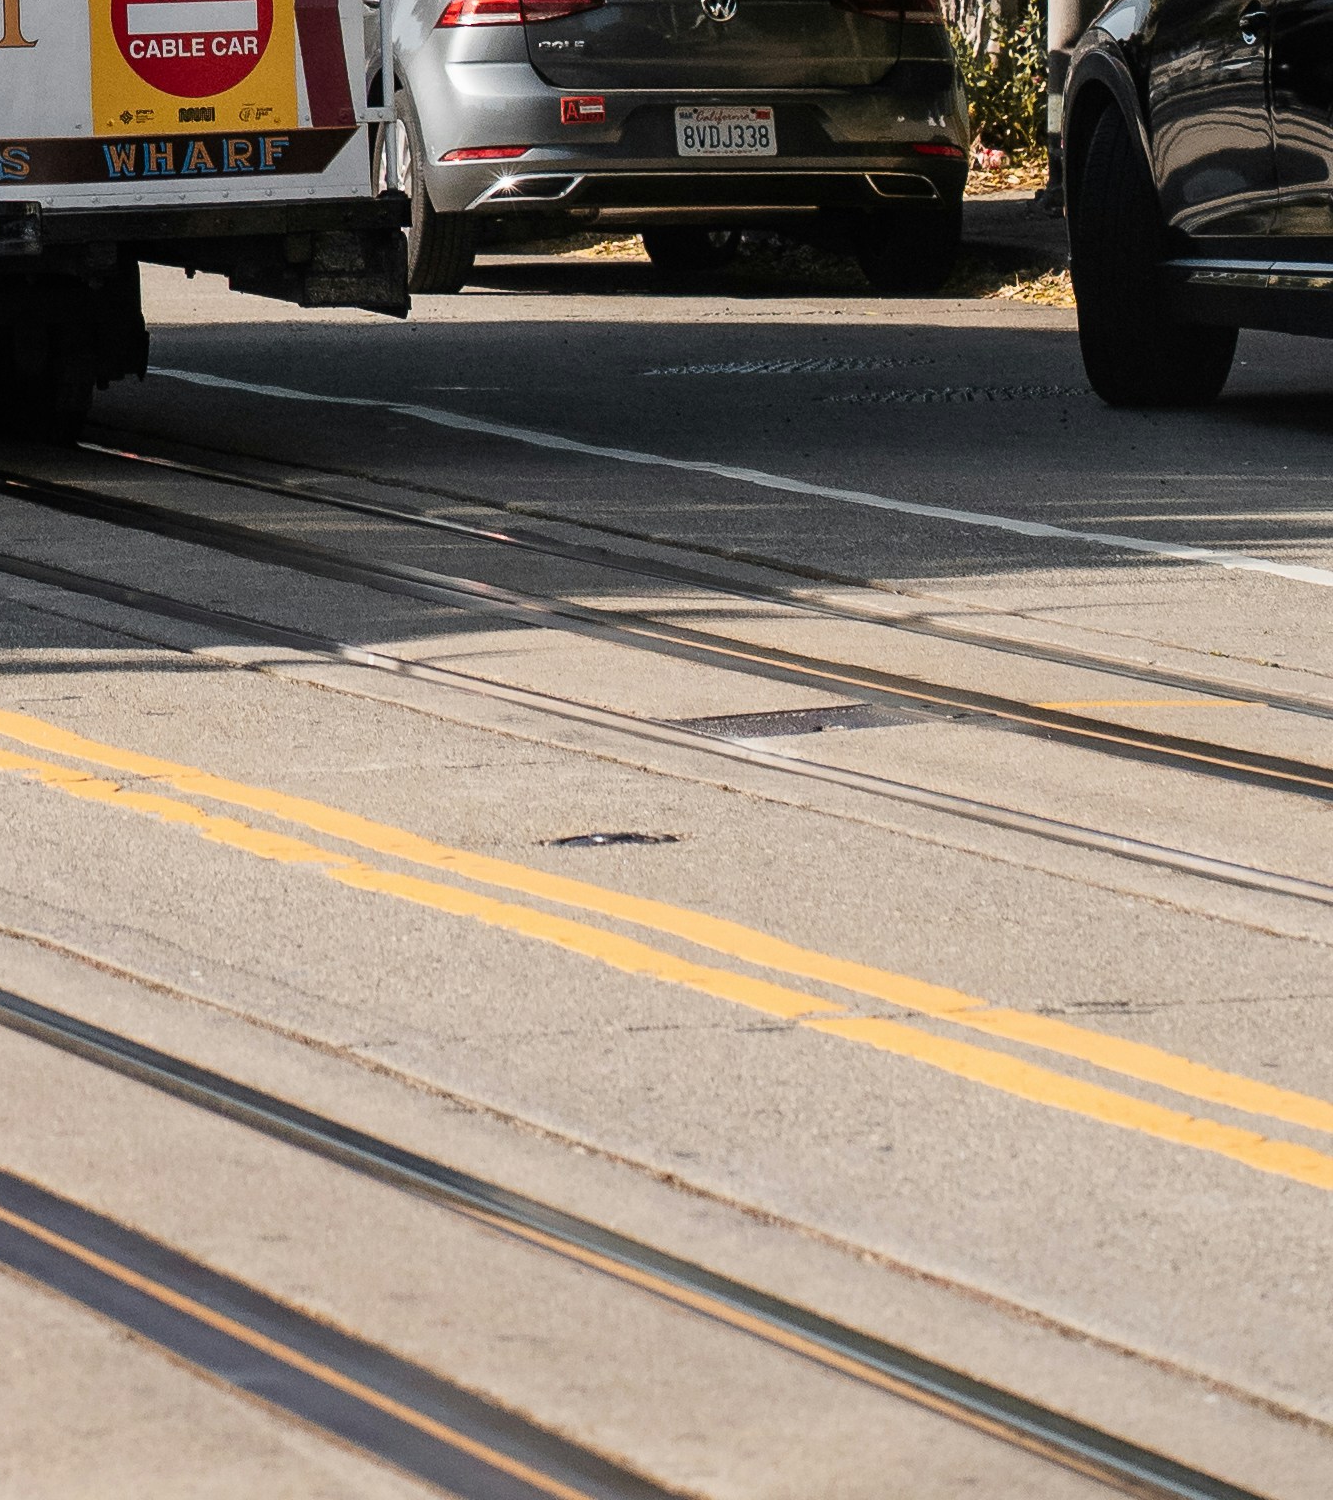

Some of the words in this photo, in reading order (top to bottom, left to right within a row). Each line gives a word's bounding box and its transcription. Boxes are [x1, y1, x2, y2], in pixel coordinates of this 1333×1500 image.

[129, 35, 207, 60] CABLE
[211, 33, 260, 58] CAR
[565, 101, 580, 120] A
[695, 109, 751, 125] California
[683, 124, 771, 150] 8VDJ338
[105, 134, 292, 180] WHARF
